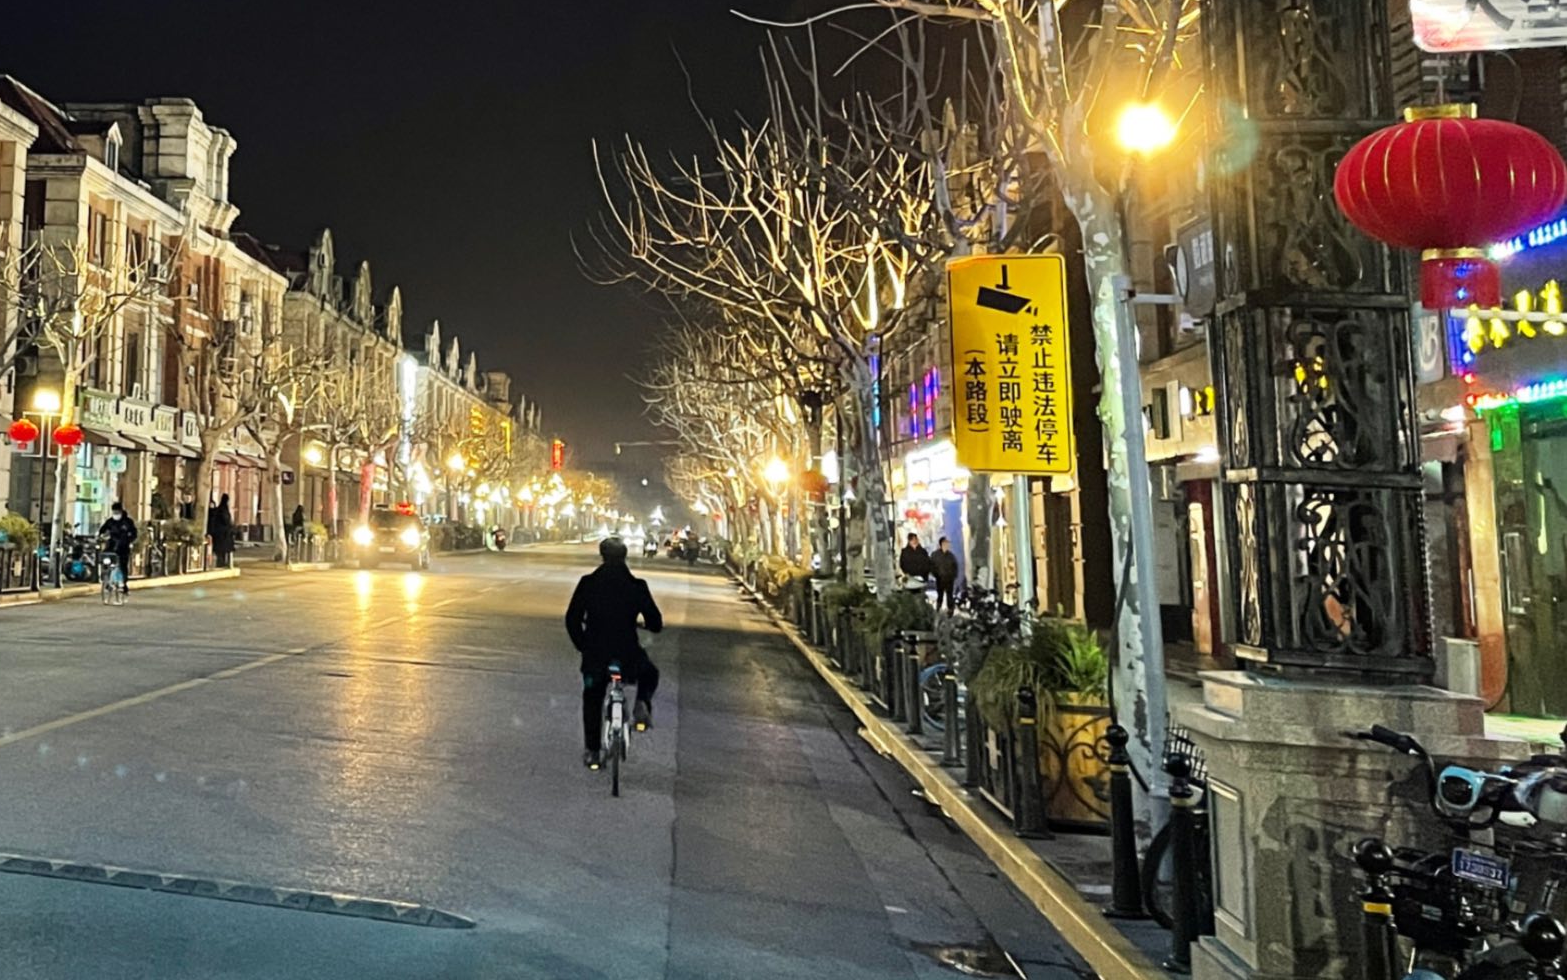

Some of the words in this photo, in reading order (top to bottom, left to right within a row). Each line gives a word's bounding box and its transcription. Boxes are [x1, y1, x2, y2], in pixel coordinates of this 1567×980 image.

[995, 332, 1023, 453] 请立即驶离
[1029, 323, 1059, 466] 禁止违法停车
